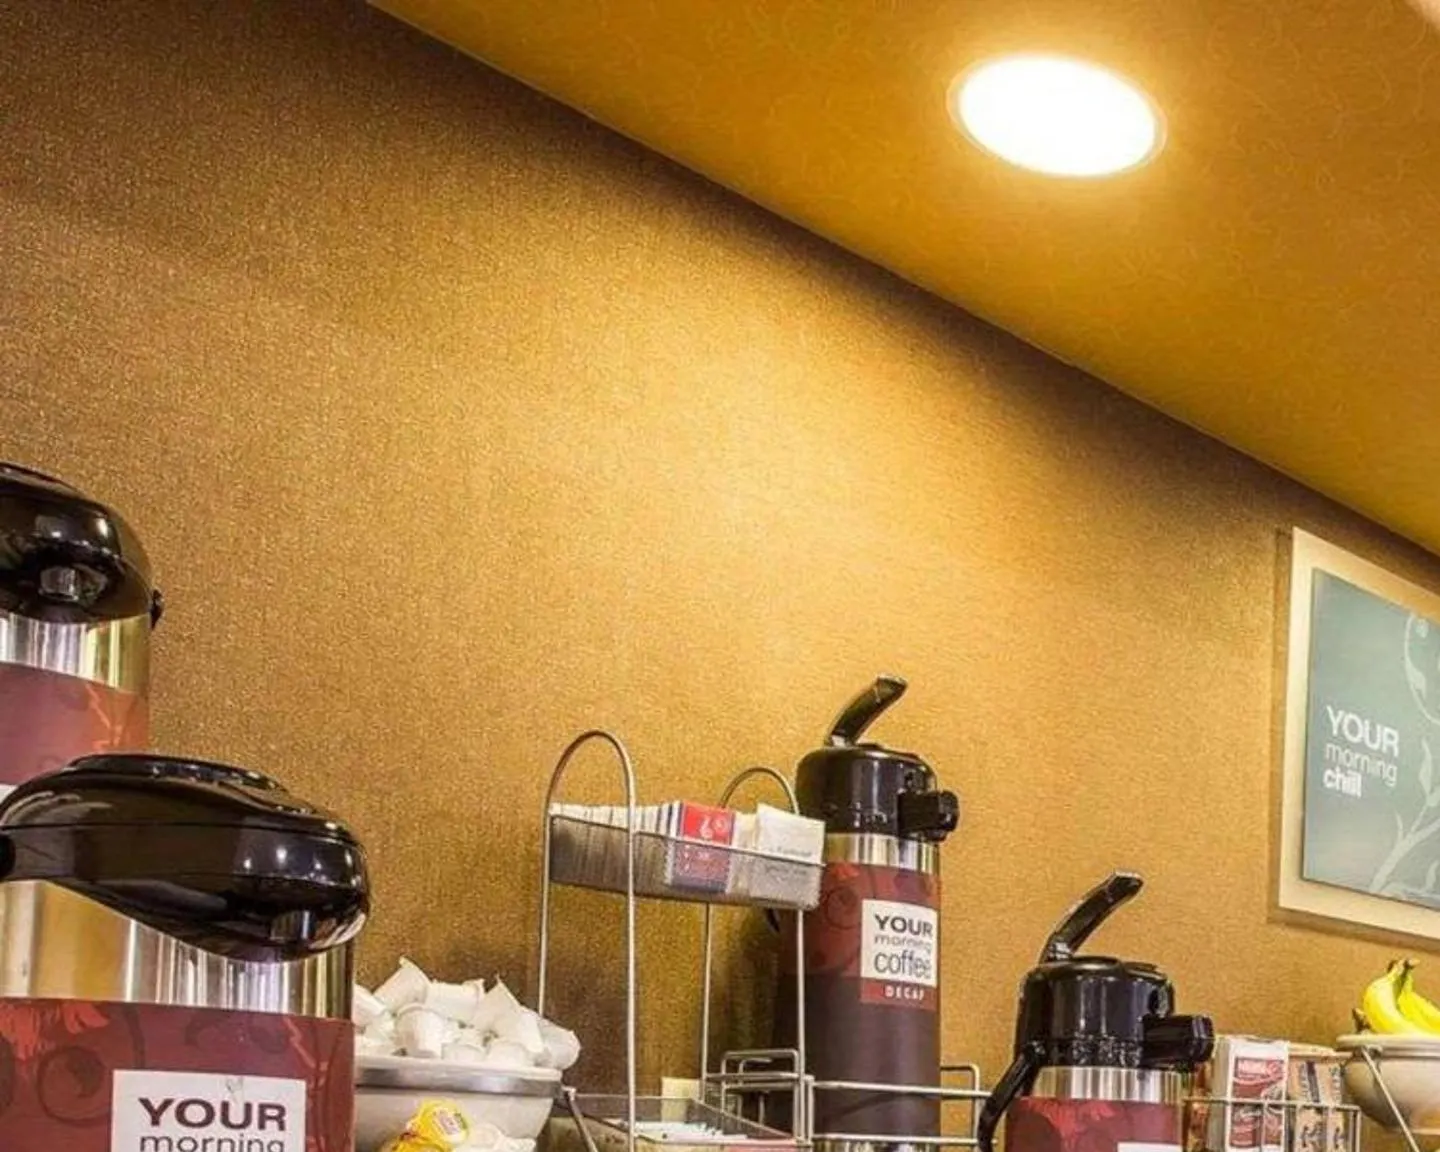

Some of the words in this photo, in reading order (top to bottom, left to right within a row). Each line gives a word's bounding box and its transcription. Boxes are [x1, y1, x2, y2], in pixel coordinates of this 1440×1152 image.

[1326, 704, 1400, 757] YOUR
[1326, 743, 1398, 787] morning
[1322, 766, 1362, 798] chill
[874, 914, 934, 937] YOUR
[874, 950, 932, 979] coffee
[885, 986, 925, 1001] DECAF
[139, 1097, 287, 1131] YOUR
